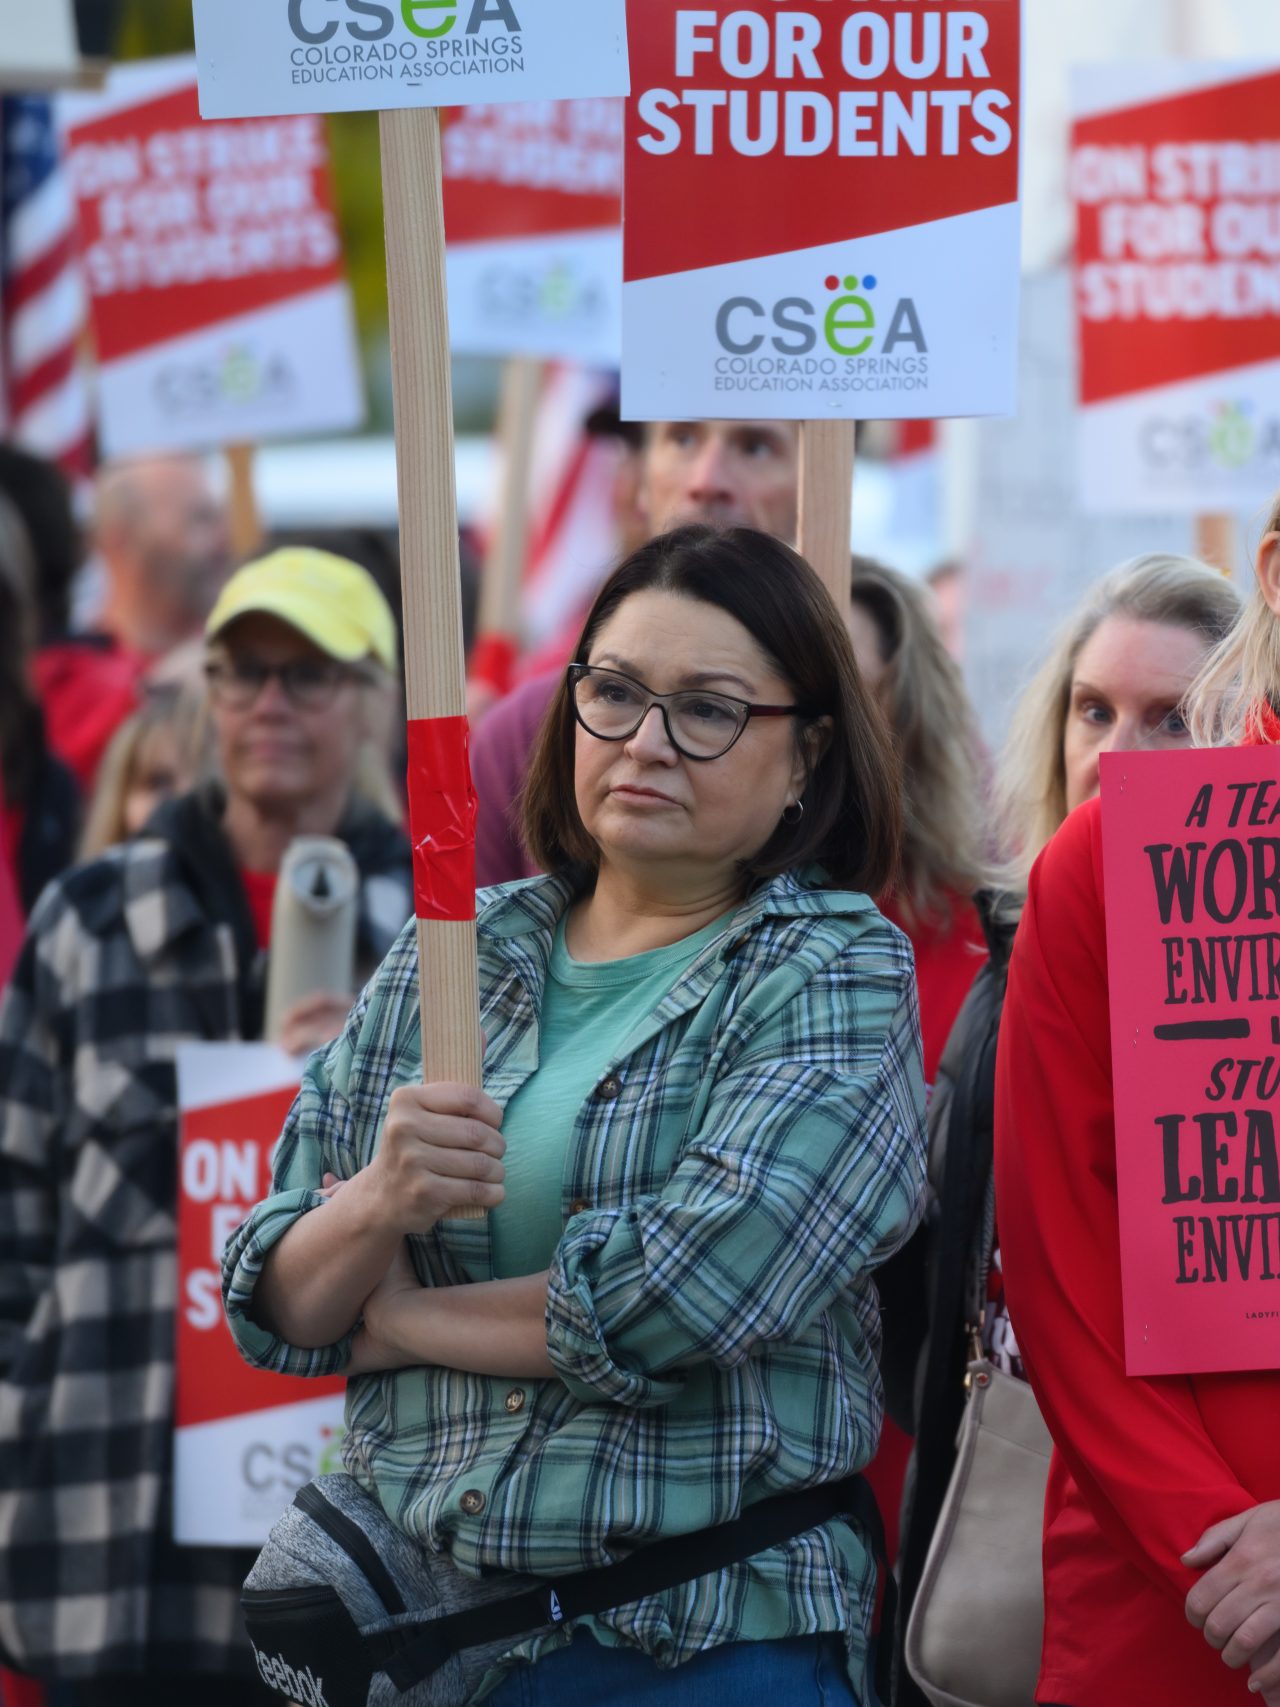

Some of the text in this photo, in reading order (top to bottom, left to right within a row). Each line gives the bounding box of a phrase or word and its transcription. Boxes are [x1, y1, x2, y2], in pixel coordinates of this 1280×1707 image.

[290, 36, 522, 66] COLORADO SPRINGS
[292, 57, 524, 84] EDUCATION ASSOCIATION
[675, 11, 991, 79] FOR OUR
[637, 88, 1012, 156] STUDENTS
[1072, 144, 1146, 204] ON
[1101, 201, 1203, 259] FOR
[715, 356, 928, 375] COLORADO SPRINGS
[715, 376, 928, 392] EDUCATION ASSOCIATION
[1185, 784, 1213, 828] A
[183, 1138, 259, 1201] ON
[250, 1638, 330, 1707] eebok
